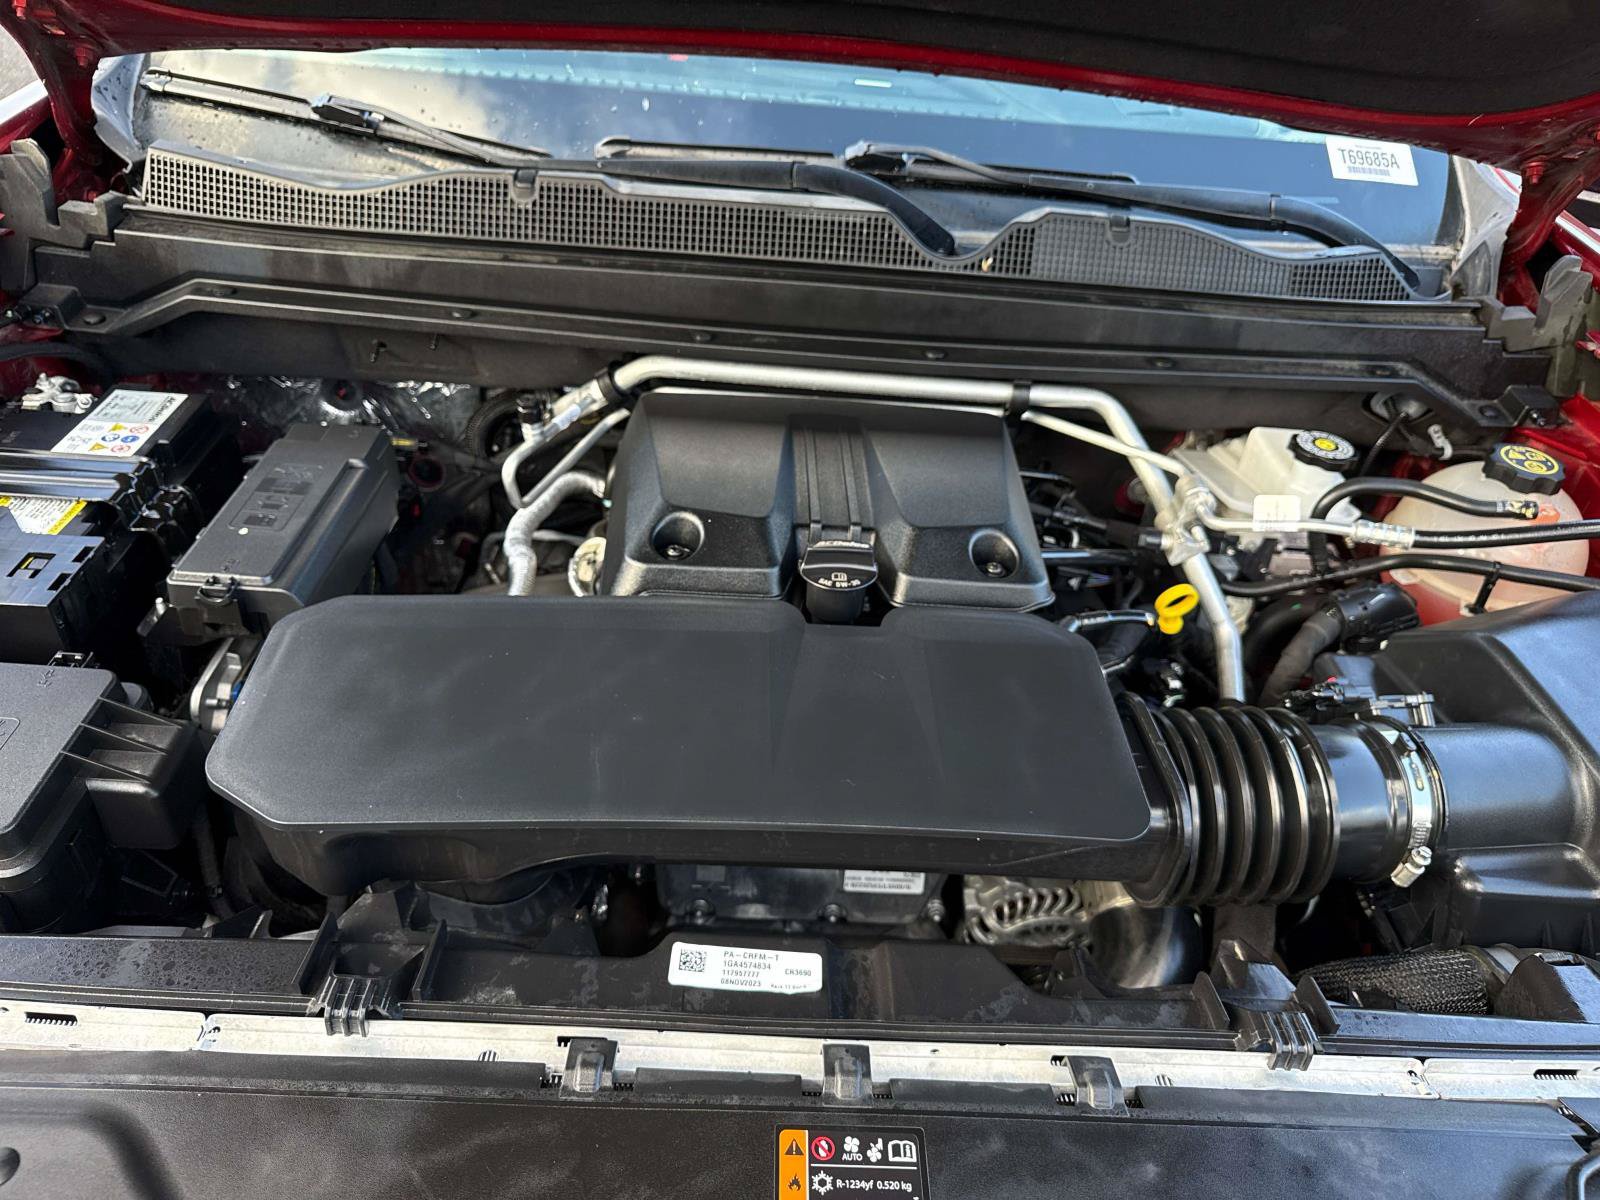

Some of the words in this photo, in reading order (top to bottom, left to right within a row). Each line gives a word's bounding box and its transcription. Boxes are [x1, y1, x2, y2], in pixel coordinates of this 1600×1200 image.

[1338, 148, 1400, 169] T69685A
[842, 1153, 863, 1162] AUTO
[837, 1179, 874, 1190] R-1234yf
[878, 1181, 900, 1190] 0.520
[901, 1181, 912, 1192] kg
